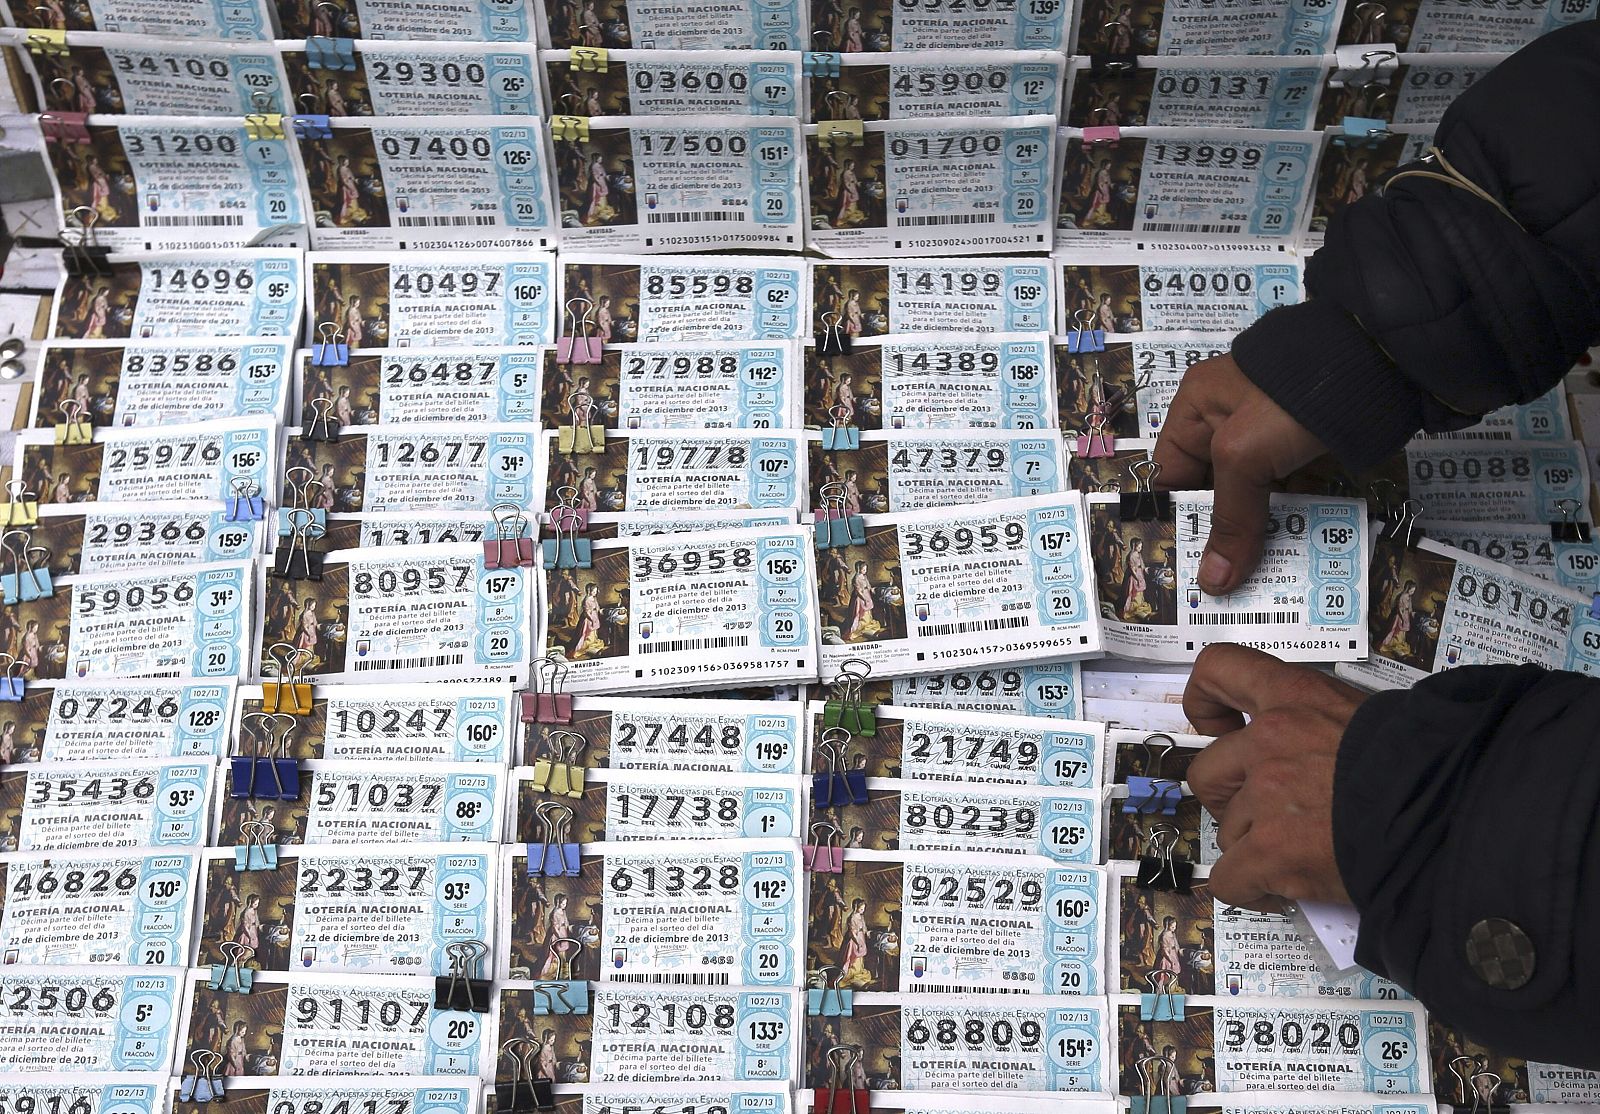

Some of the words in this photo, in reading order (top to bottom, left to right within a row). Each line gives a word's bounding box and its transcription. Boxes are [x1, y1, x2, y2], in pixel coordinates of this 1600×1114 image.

[117, 56, 228, 76] 34100
[374, 61, 484, 83] 29300
[636, 70, 747, 90] 03600
[895, 71, 1006, 92] 45900
[1158, 76, 1269, 95] 00131
[129, 135, 236, 154] 31200
[382, 137, 490, 157] 07400
[642, 135, 746, 154] 17500
[891, 135, 1001, 156] 01700
[1154, 145, 1260, 165] 13999
[643, 161, 684, 169] LOTERÍA
[690, 161, 743, 169] NACIONAL
[895, 164, 938, 174] LOTERÍA
[943, 163, 996, 171] NACIONAL
[767, 199, 782, 210] 20
[151, 269, 253, 291] 14696
[394, 272, 500, 293] 40497
[648, 276, 753, 294] 85598
[897, 272, 1001, 292] 14199
[1144, 271, 1252, 293] 64000
[127, 354, 235, 373] 83586
[628, 357, 737, 375] 27988
[893, 352, 998, 371] 14389
[386, 361, 495, 384] 26487
[111, 442, 220, 468] 25976
[377, 442, 485, 463] 12677
[637, 447, 745, 466] 19778
[892, 449, 1004, 468] 47379
[1416, 458, 1530, 481] 00088
[1038, 511, 1065, 520] 102/13
[90, 522, 205, 543] 29366
[906, 522, 1023, 555] 36959
[635, 549, 750, 577] 36958
[912, 564, 960, 576] LOTERÍA
[964, 558, 1022, 571] NACIONAL
[354, 566, 470, 594] 80957
[924, 574, 951, 582] Décima
[953, 572, 972, 580] parte
[80, 583, 194, 613] 59056
[929, 591, 941, 599] de
[943, 587, 986, 597] diciembre
[1002, 584, 1023, 593] 2013
[1458, 576, 1571, 624] 00104
[1053, 596, 1071, 610] 20
[1454, 610, 1503, 629] LOTERÍA
[1507, 624, 1559, 648] NACIONAL
[60, 697, 178, 719] 07246
[337, 708, 452, 732] 10247
[618, 724, 740, 747] 27448
[912, 733, 1038, 765] 21749
[33, 777, 154, 802] 35436
[317, 783, 441, 807] 51037
[617, 794, 738, 820] 17738
[907, 805, 1035, 831] 80239
[13, 868, 136, 895] 46826
[300, 866, 427, 893] 22327
[611, 866, 739, 891] 61328
[912, 876, 1042, 904] 92529
[12, 906, 61, 917] LOTERÍA
[64, 904, 124, 914] NACIONAL
[614, 906, 665, 915] LOTERÍA
[670, 905, 732, 914] NACIONAL
[912, 916, 965, 926] LOTERÍA
[970, 918, 1033, 928] NACIONAL
[643, 935, 688, 943] diciembre
[759, 954, 778, 968] 20
[0, 988, 115, 1011] 2506
[296, 997, 429, 1026] 91107
[607, 1004, 734, 1028] 12108
[908, 1020, 1040, 1046] 68809
[1225, 1021, 1359, 1048] 38020
[1227, 1062, 1282, 1071] LOTERÍA
[1288, 1063, 1353, 1072] NACIONAL
[743, 1098, 773, 1106] 102/13
